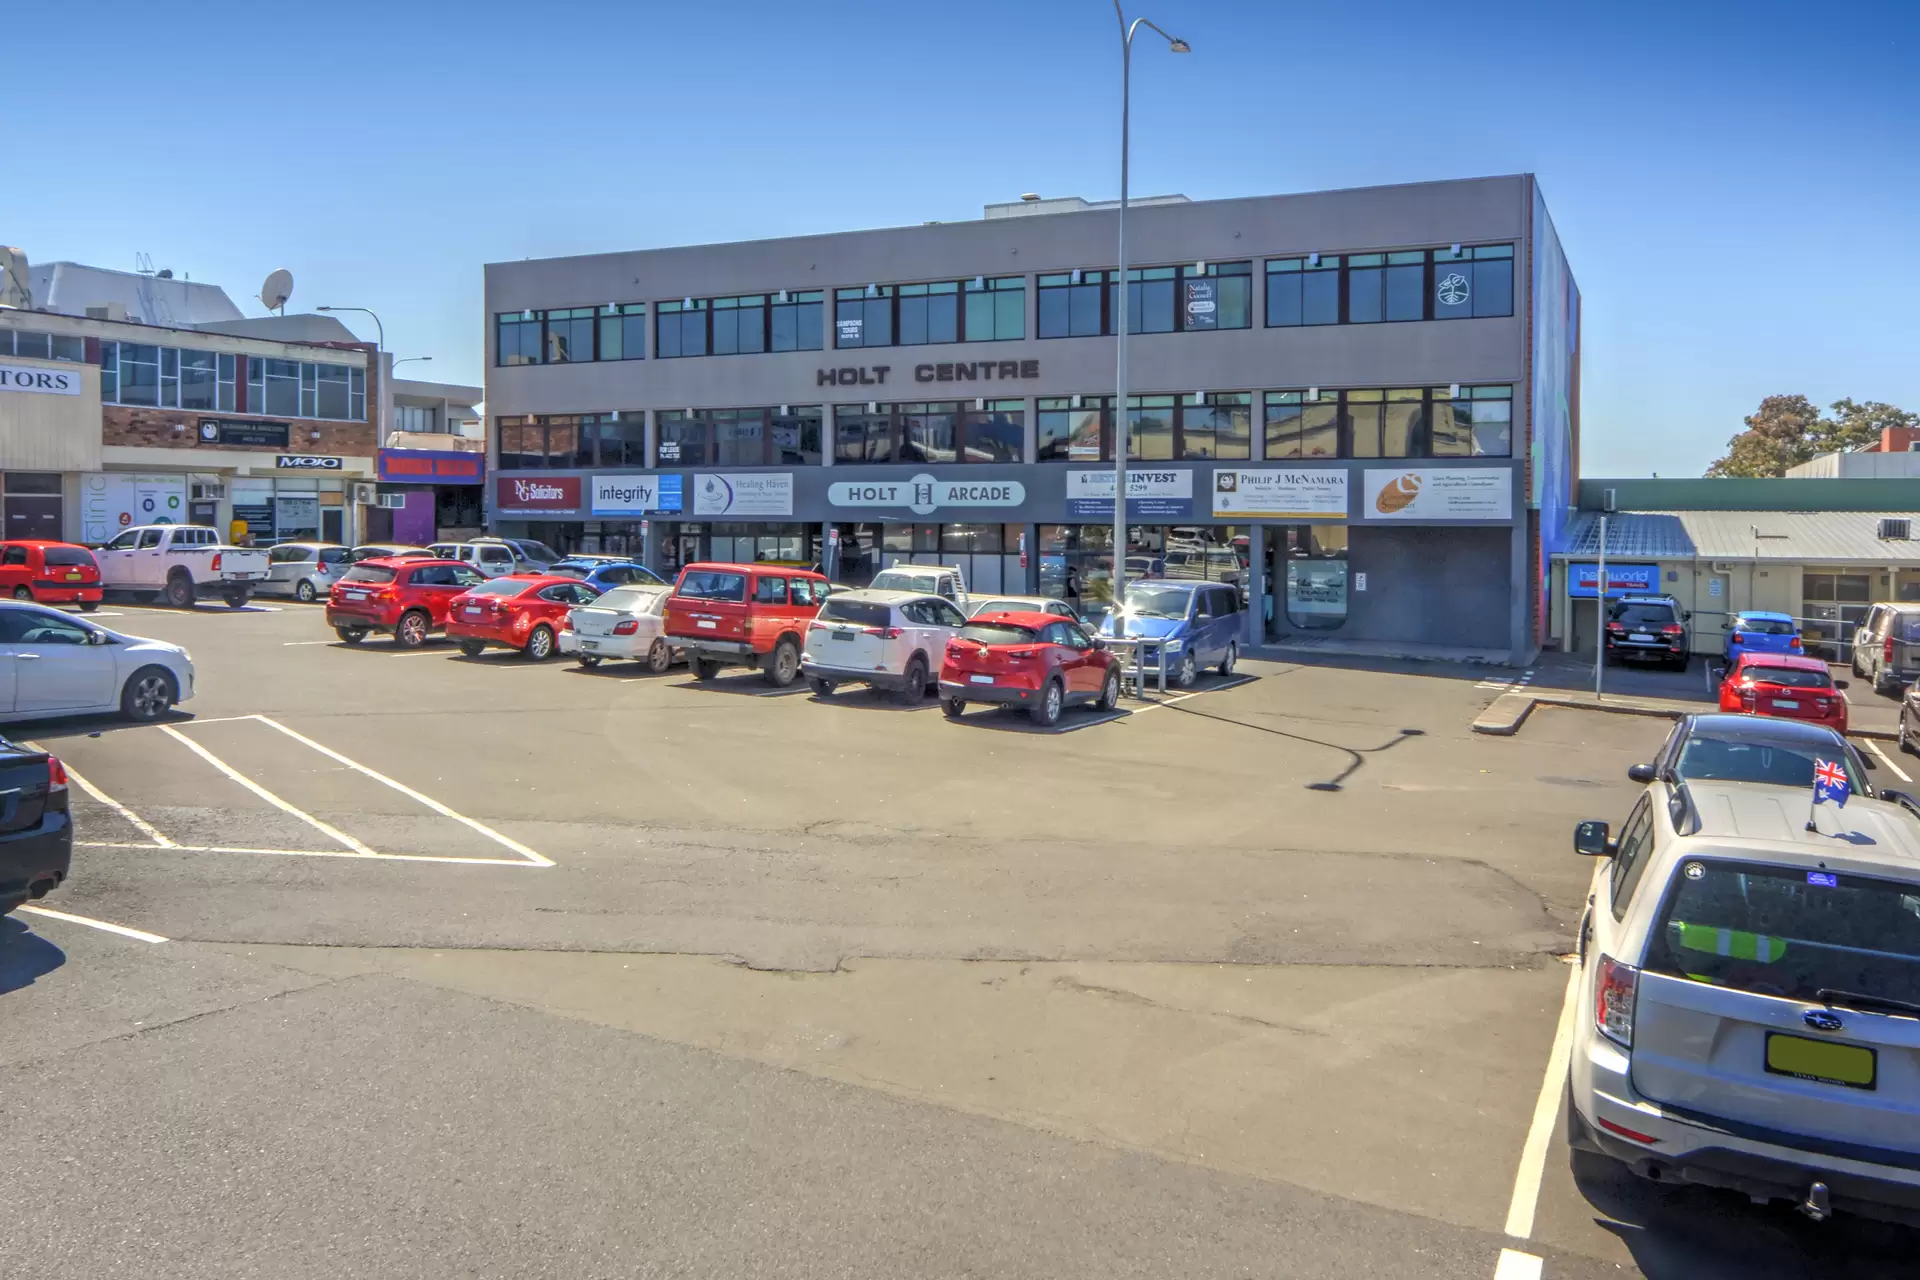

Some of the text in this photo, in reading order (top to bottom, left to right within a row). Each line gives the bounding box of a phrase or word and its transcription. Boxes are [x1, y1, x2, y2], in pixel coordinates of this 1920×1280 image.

[816, 359, 1039, 387] HOLT CENTRE
[279, 457, 338, 468] MOJO
[736, 480, 764, 491] Healing
[1275, 474, 1281, 484] J
[600, 485, 652, 502] integrity
[849, 487, 897, 501] HOLT
[948, 487, 1010, 500] ARCADE
[84, 475, 107, 541] clinic
